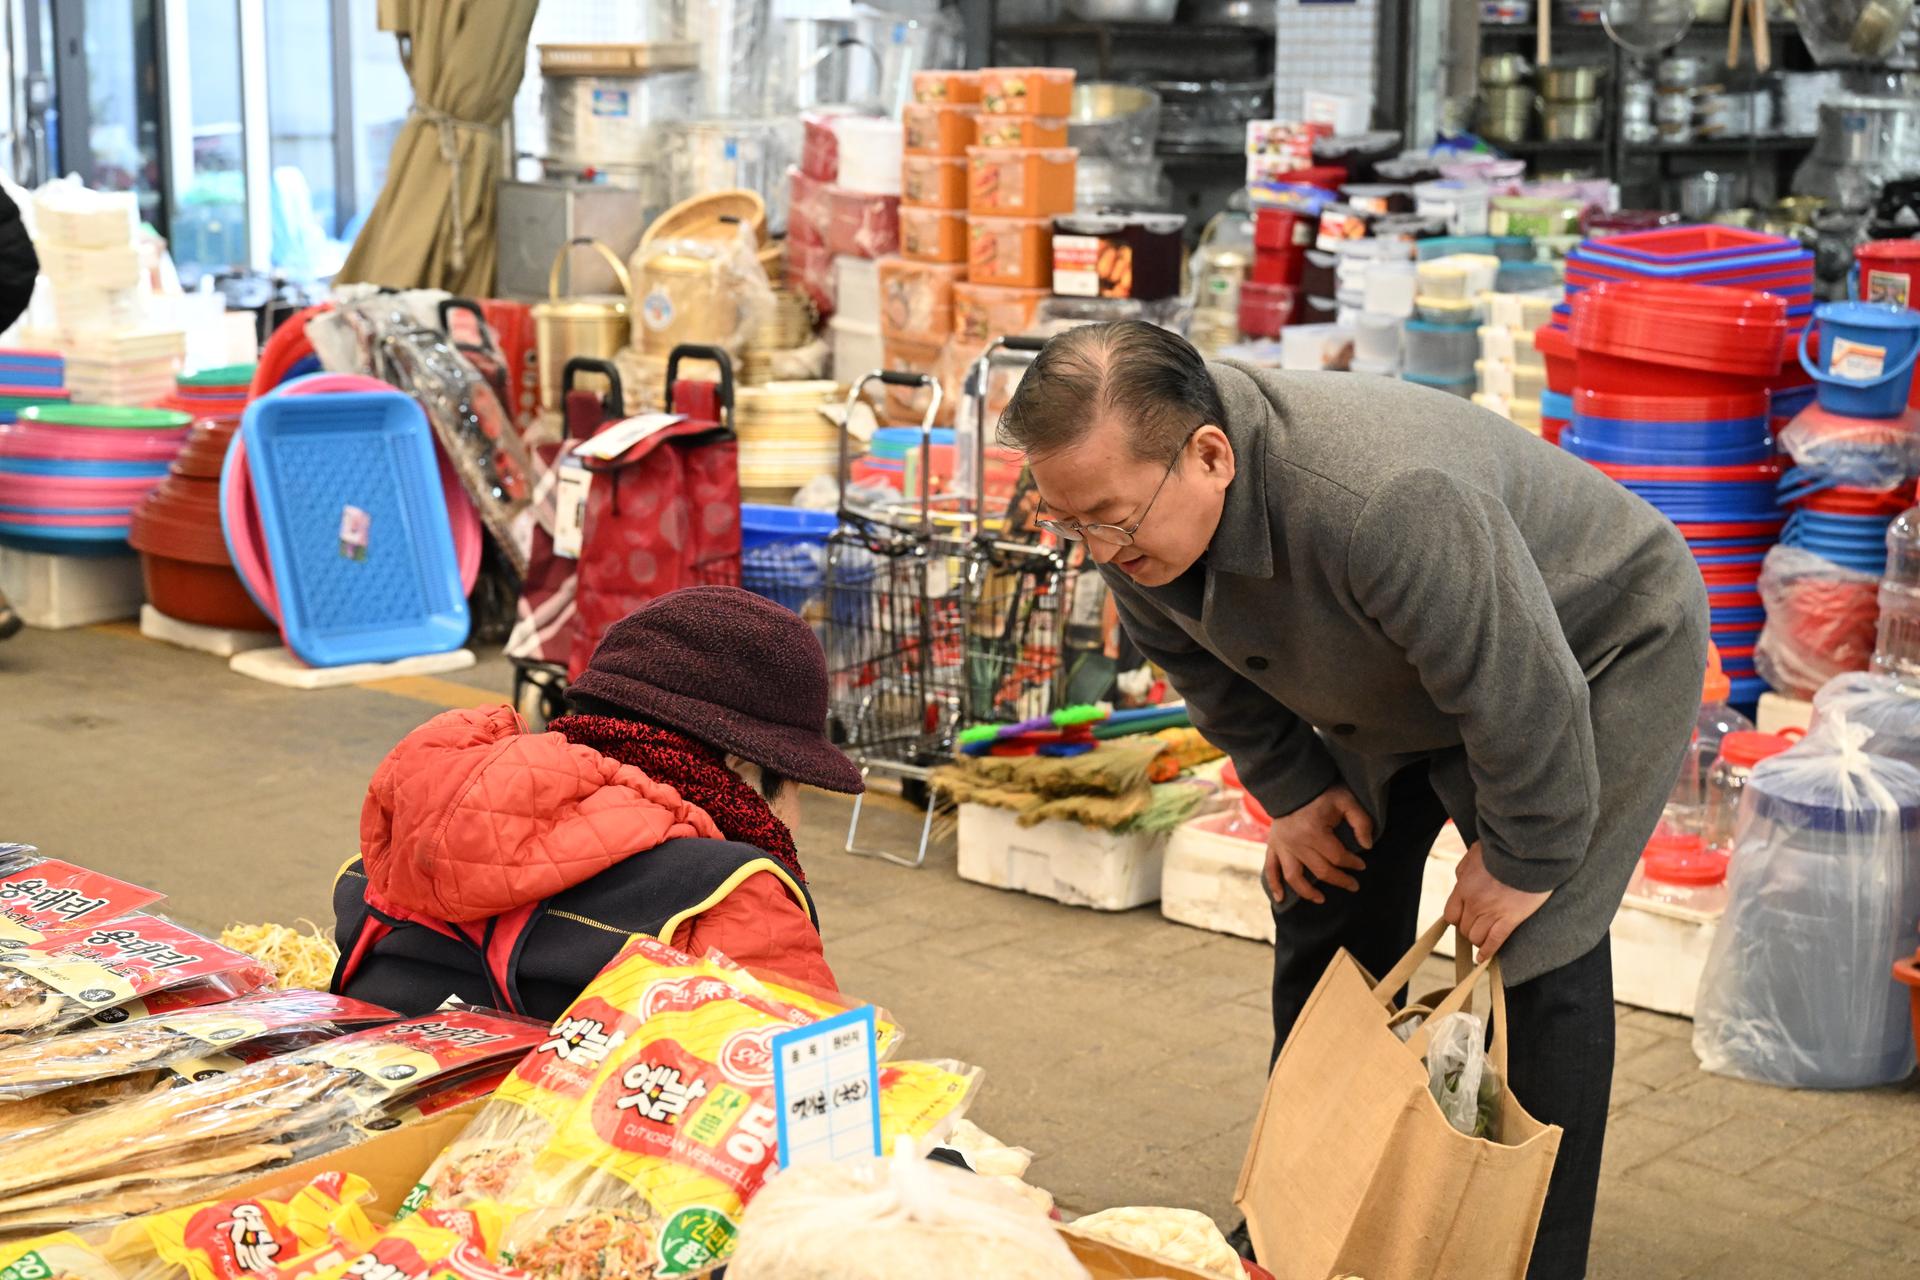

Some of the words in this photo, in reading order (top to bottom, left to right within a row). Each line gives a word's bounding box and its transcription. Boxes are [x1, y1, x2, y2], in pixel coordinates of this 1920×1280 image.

[0, 879, 107, 922] 용대리
[86, 929, 201, 970] 용대리
[388, 1022, 513, 1047] 용대리
[537, 1015, 627, 1068] 옛날
[615, 1062, 707, 1125] 옛날
[624, 1122, 645, 1139] CUT
[642, 1128, 687, 1153] KOREAN
[403, 1187, 428, 1209] 20
[11, 1253, 46, 1280] 20
